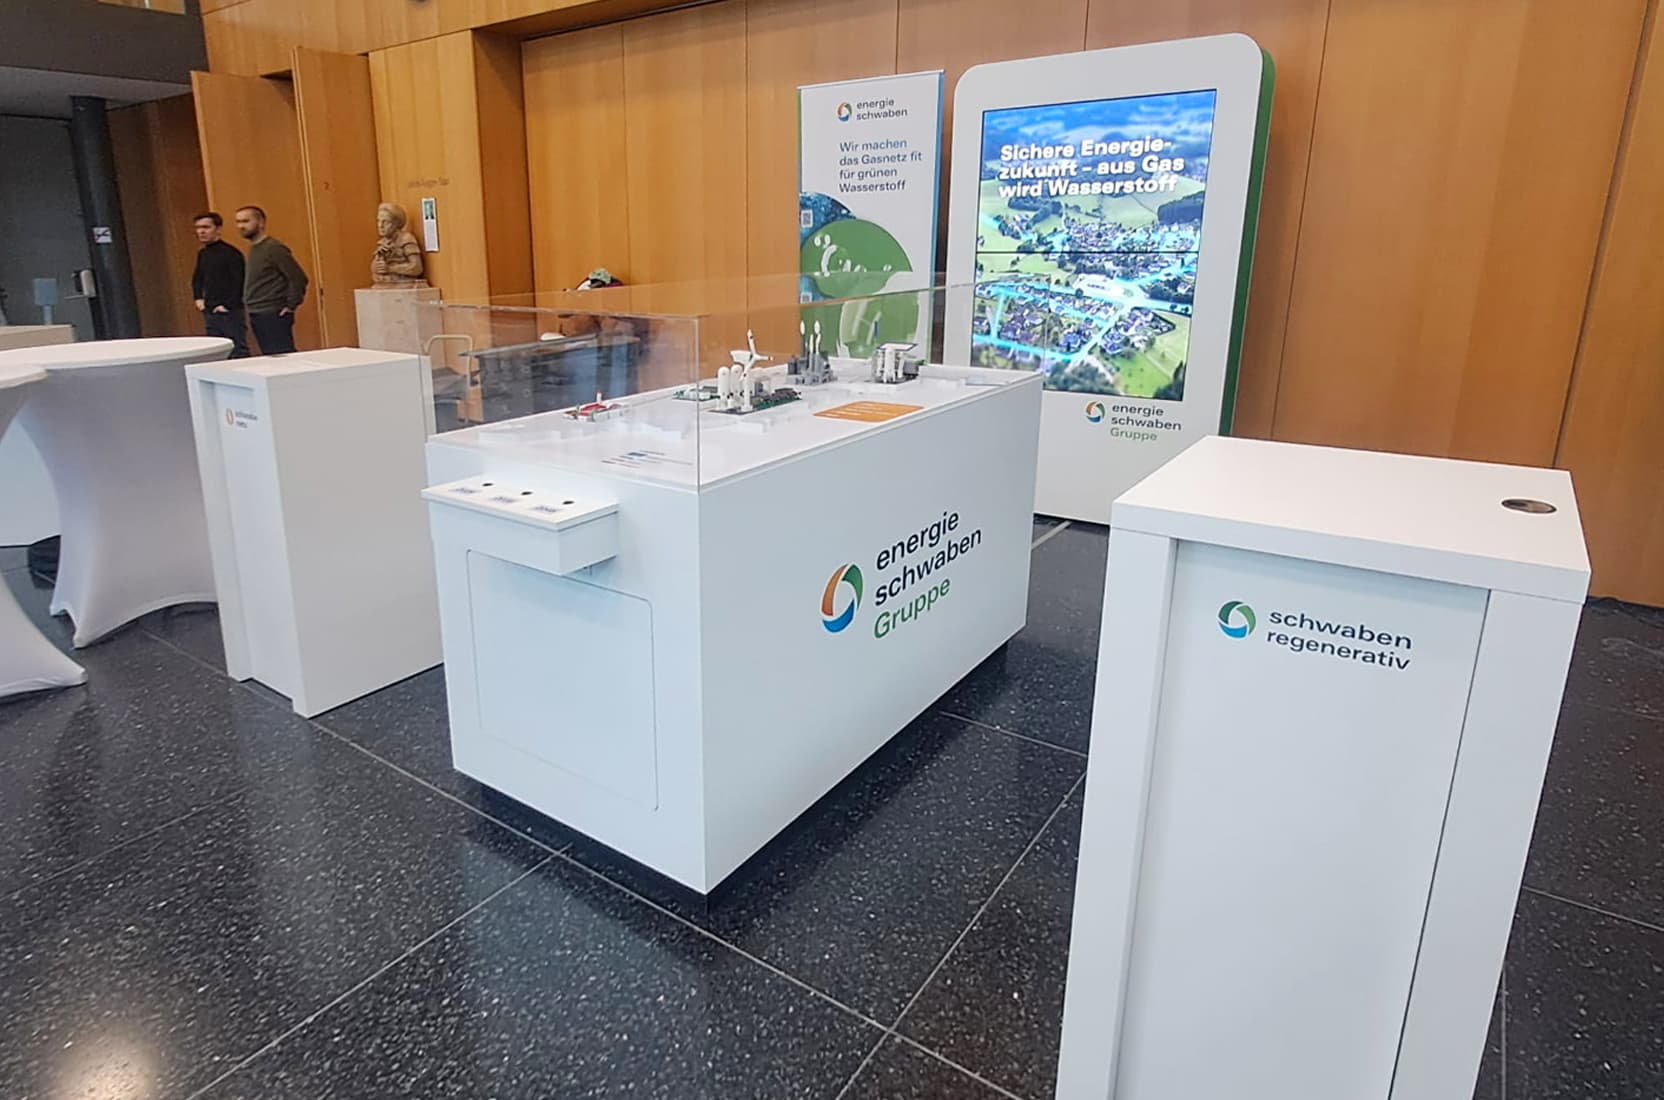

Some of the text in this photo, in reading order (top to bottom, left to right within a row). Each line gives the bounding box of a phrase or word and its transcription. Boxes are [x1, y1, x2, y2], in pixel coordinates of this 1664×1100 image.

[856, 98, 895, 109] energie
[856, 108, 908, 121] schwaben
[840, 138, 908, 153] Wir machen
[1001, 136, 1172, 161] Sichere Energie-
[839, 150, 923, 167] das Gasnetz fit
[839, 166, 897, 181] für grünen
[999, 160, 1077, 180] zukunft
[1097, 162, 1135, 175] aus
[1142, 155, 1185, 174] Gas
[839, 180, 906, 193] Wasserstoff
[999, 174, 1179, 198] wird Wasserstoff
[1112, 404, 1164, 417] energie
[1111, 416, 1182, 431] schwaben
[1110, 427, 1157, 441] Gruppe
[876, 511, 959, 571] energie
[875, 529, 982, 606] schwaben
[874, 578, 950, 639] Gruppe
[1269, 611, 1412, 649] schwaben
[1267, 631, 1410, 670] regenerativ
